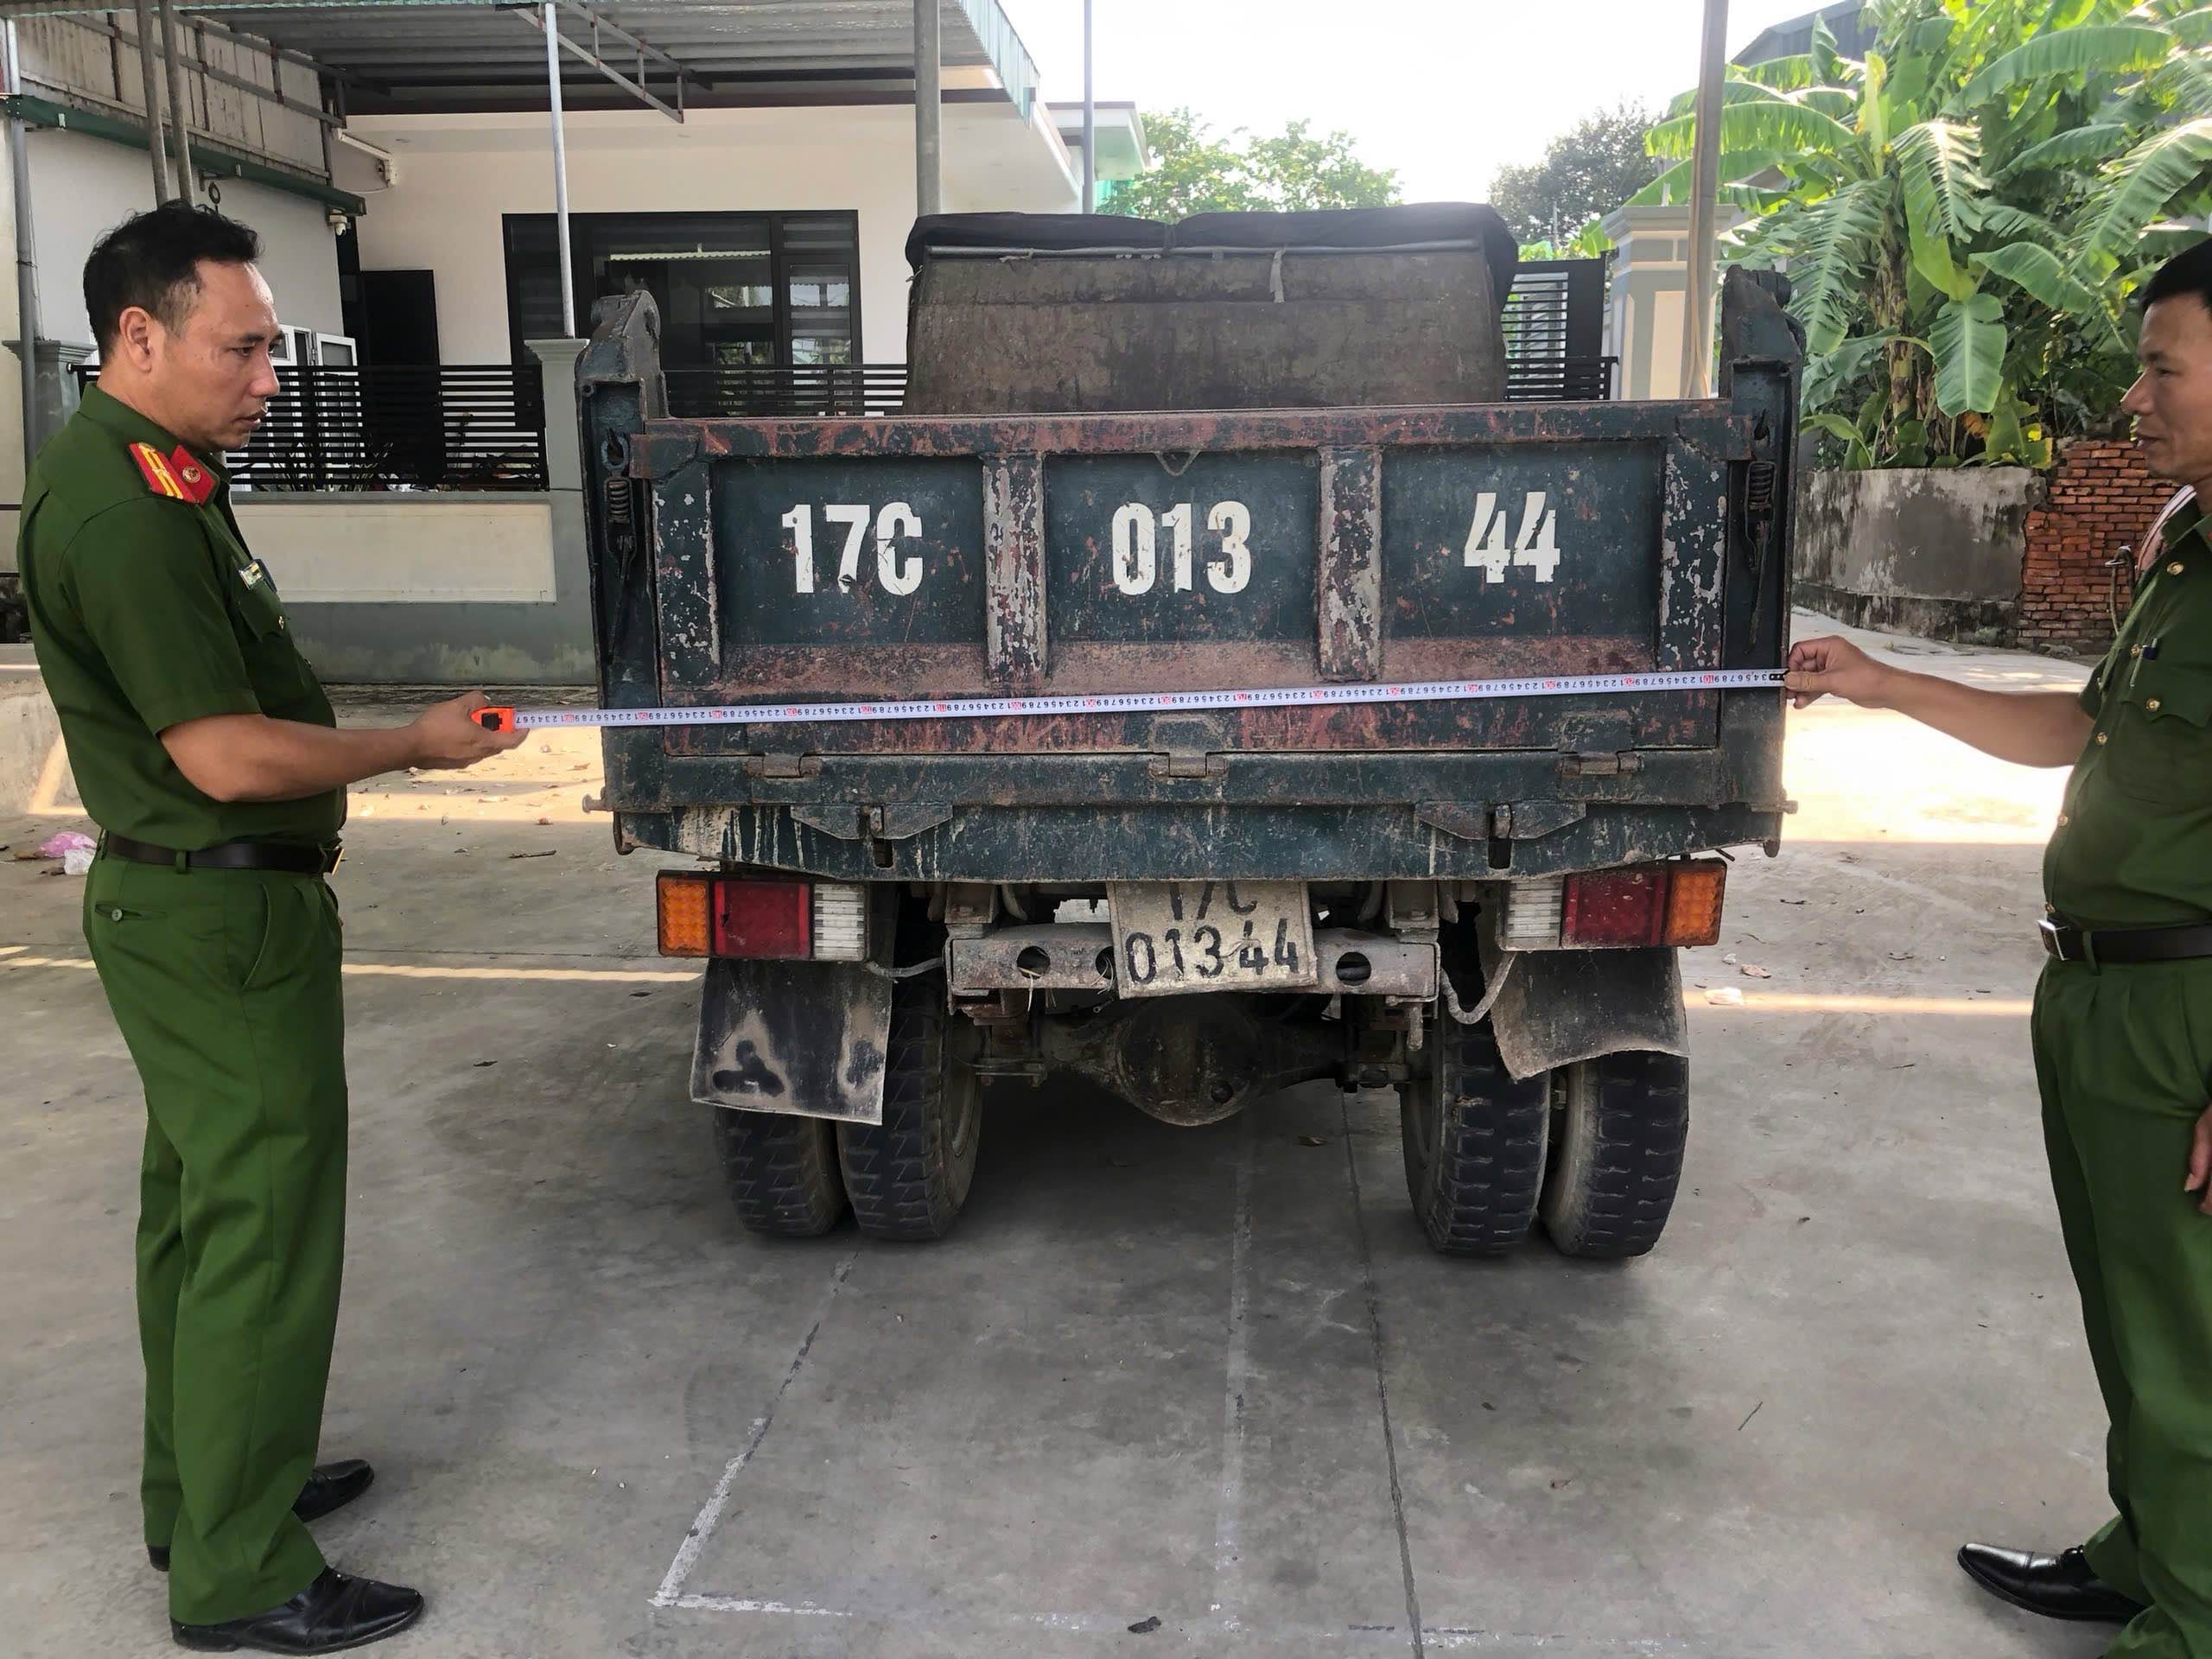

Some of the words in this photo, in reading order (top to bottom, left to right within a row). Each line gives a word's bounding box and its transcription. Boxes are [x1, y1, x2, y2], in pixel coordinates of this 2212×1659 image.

[782, 502, 923, 595] 17C
[1112, 500, 1251, 595] 013
[1464, 492, 1560, 583] 44
[1126, 918, 1299, 984] 01344
